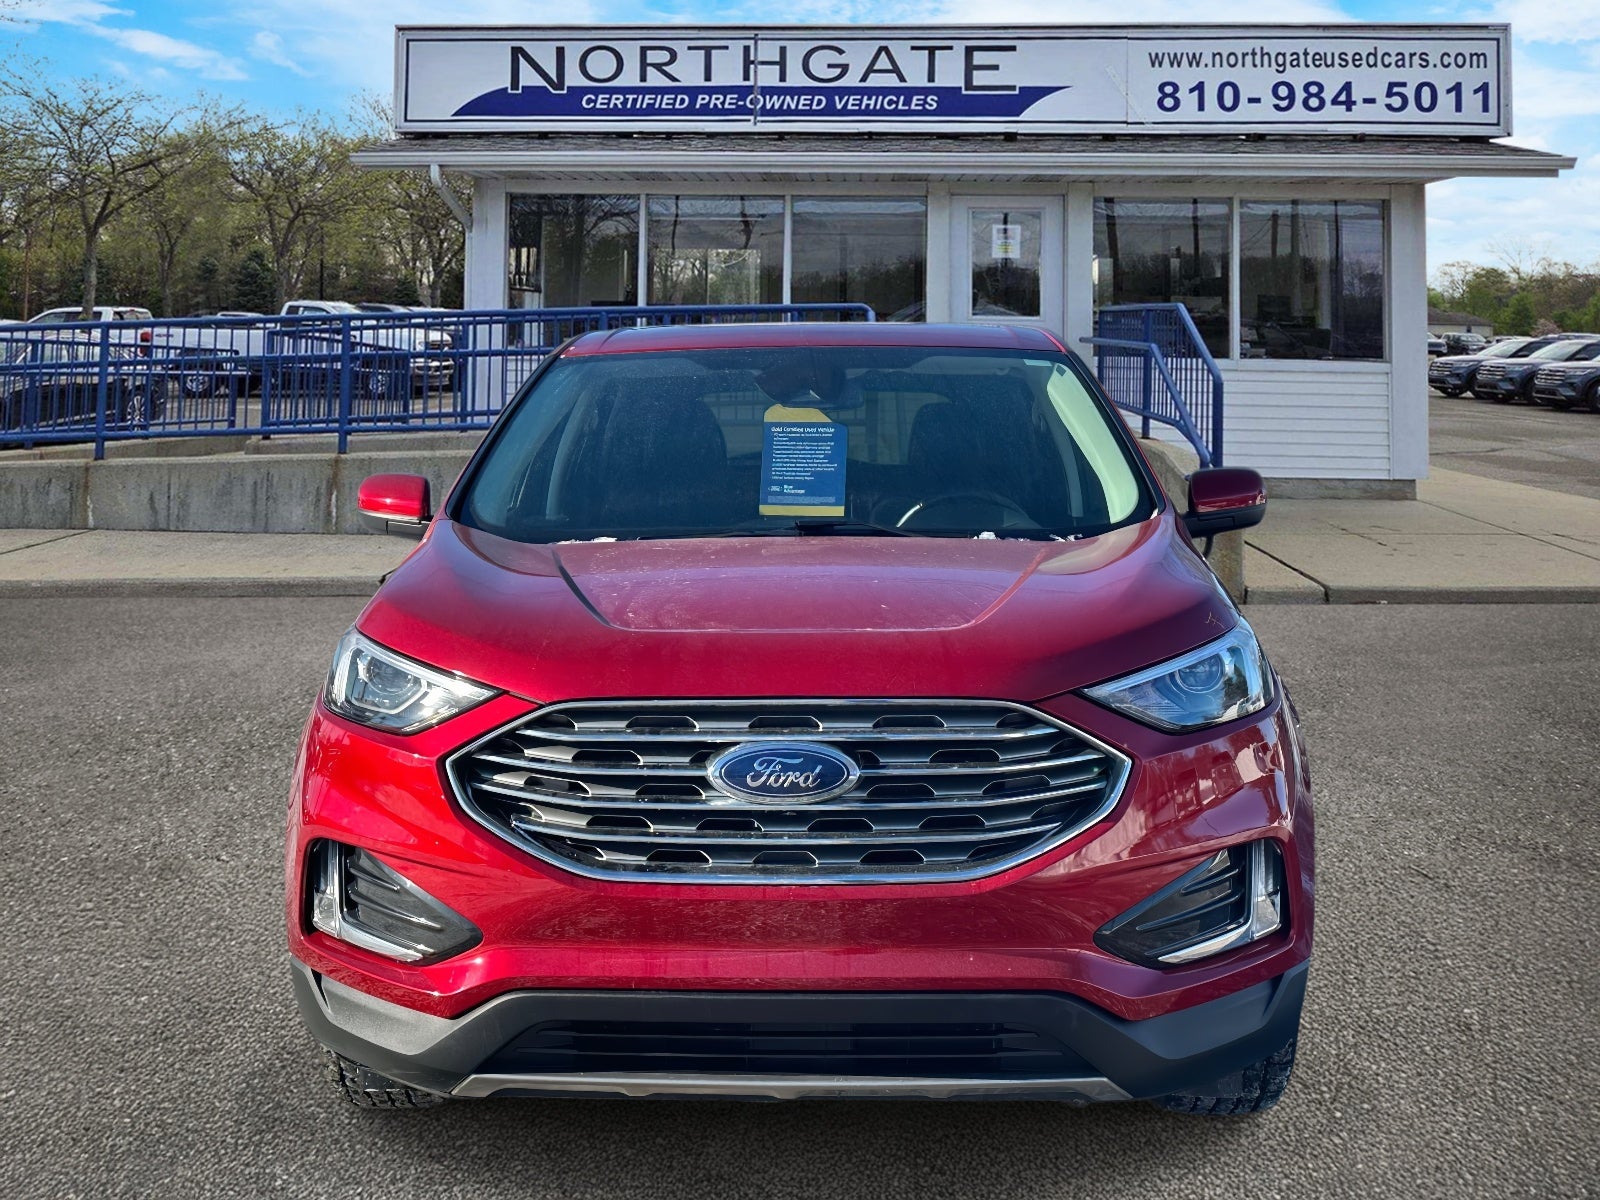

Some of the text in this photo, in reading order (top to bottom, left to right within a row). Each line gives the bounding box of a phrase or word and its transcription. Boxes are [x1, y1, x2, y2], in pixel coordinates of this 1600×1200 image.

[510, 45, 1018, 93] NORTHGATE
[1148, 47, 1488, 74] www.northgateusedcars.com
[582, 94, 938, 110] CERTIFIED PRE-OWNED VEHICLES
[1156, 80, 1491, 114] 810-984-5011
[746, 756, 822, 788] Ford
